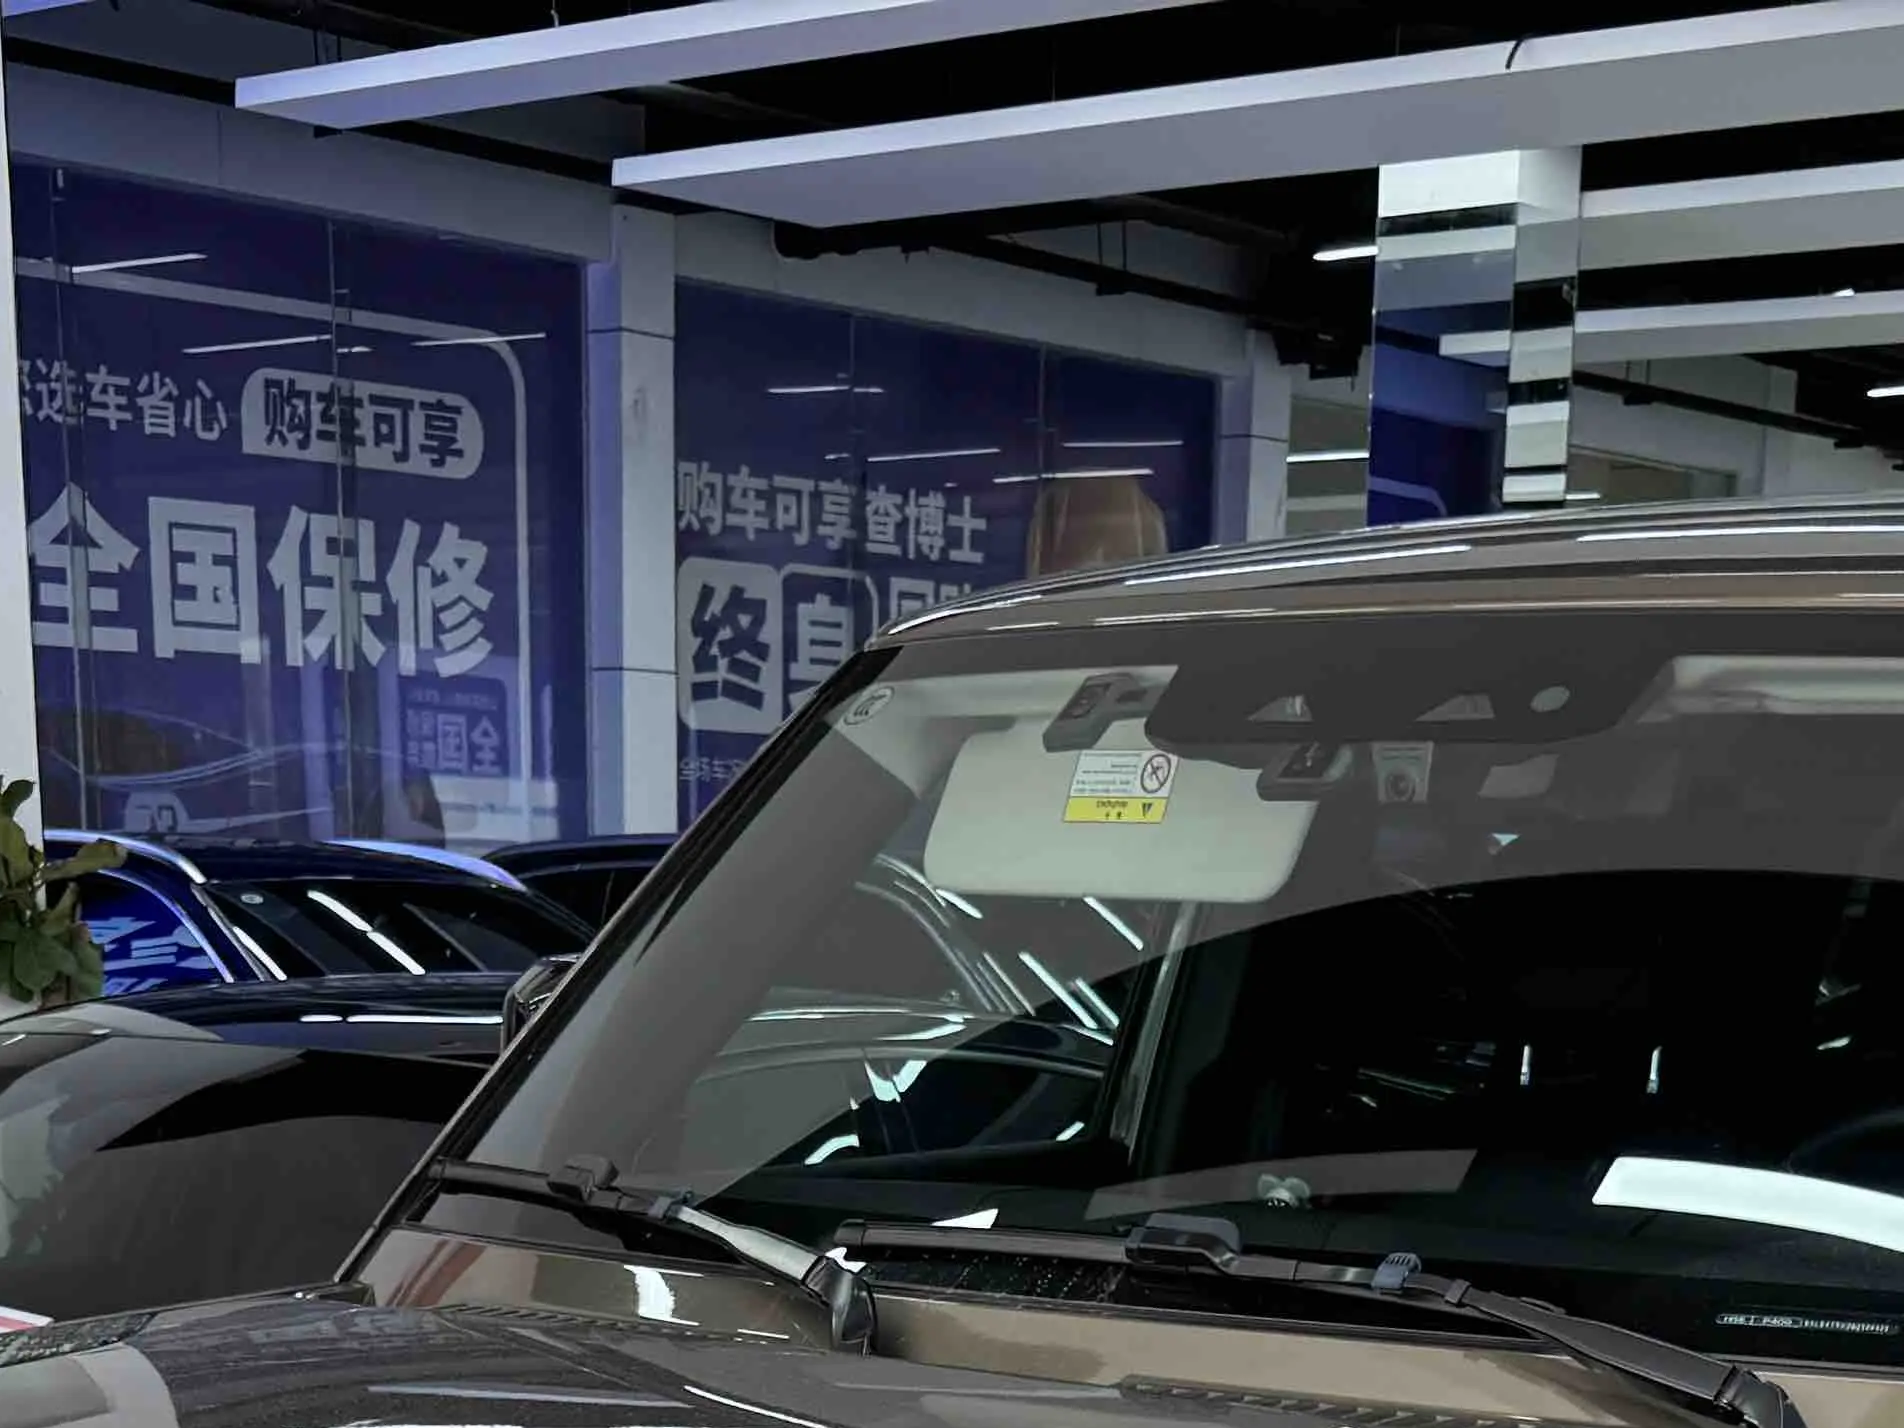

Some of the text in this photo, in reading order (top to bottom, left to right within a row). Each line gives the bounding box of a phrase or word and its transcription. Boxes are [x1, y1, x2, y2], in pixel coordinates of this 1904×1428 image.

[263, 377, 465, 468] 购车可享
[677, 461, 987, 563] 购车可享查博士
[26, 482, 494, 677] 全国保修
